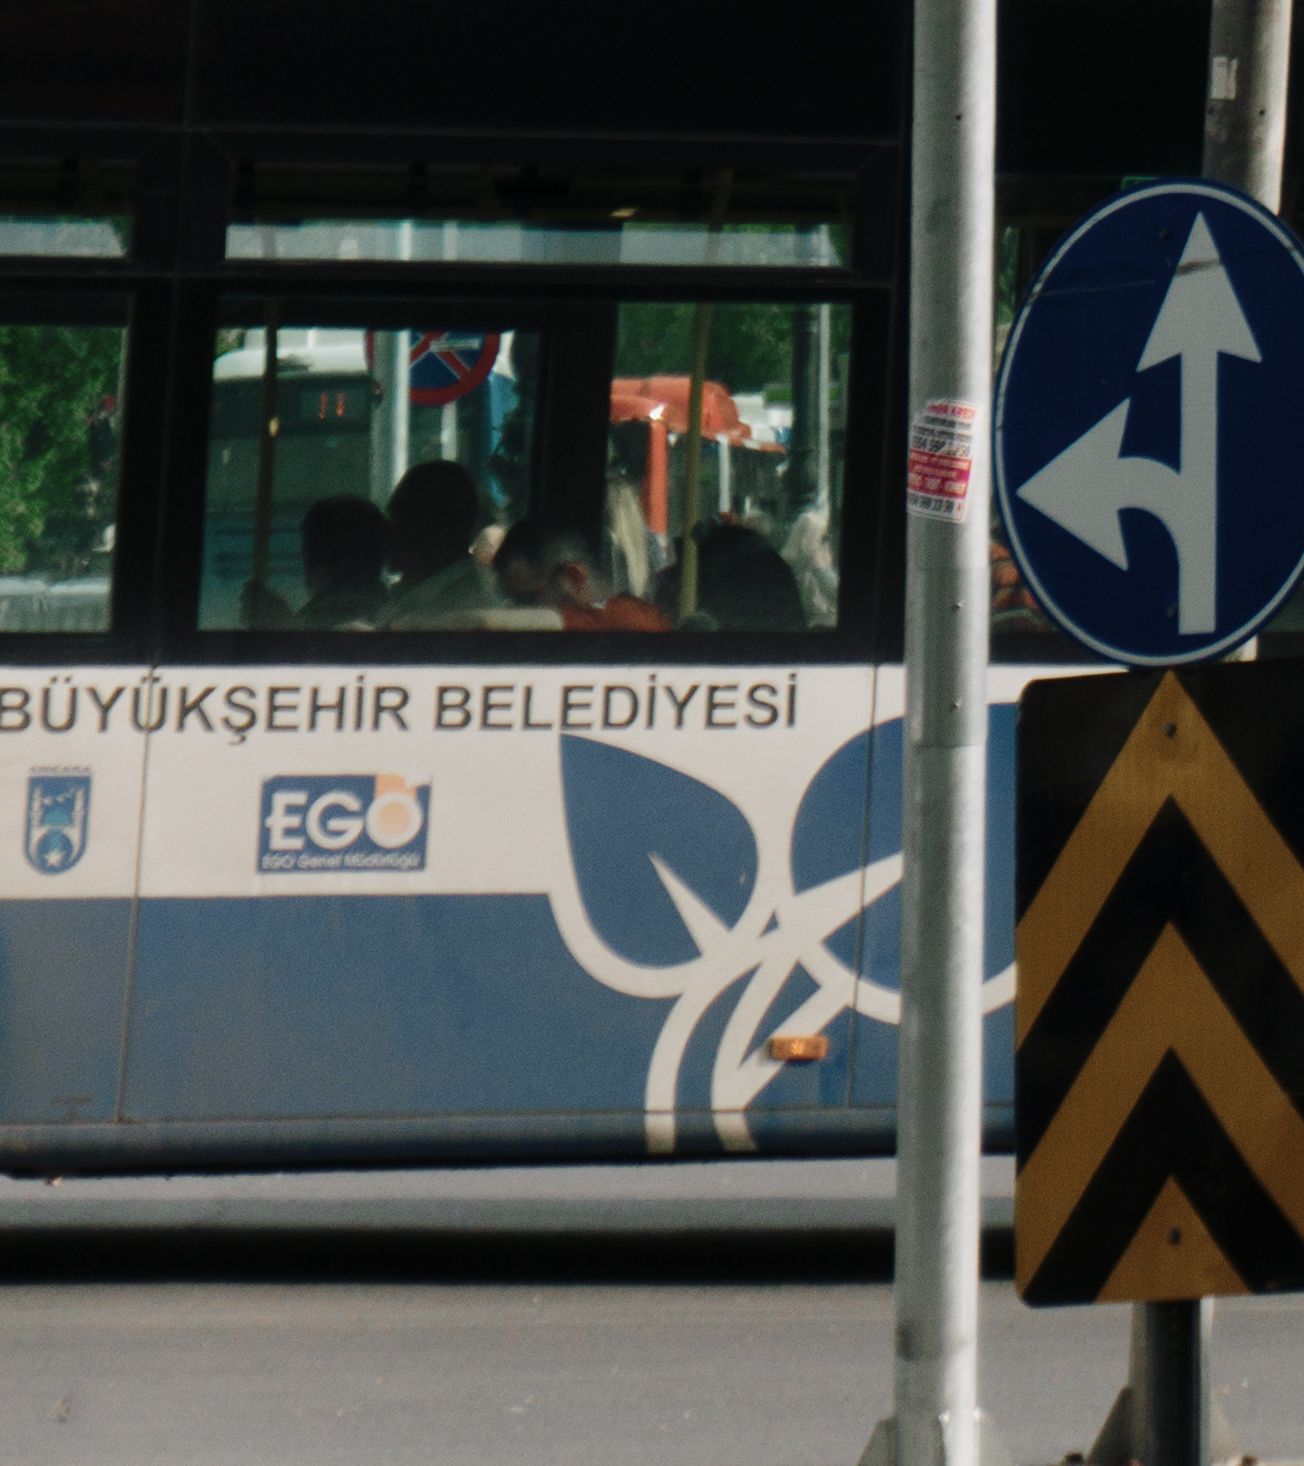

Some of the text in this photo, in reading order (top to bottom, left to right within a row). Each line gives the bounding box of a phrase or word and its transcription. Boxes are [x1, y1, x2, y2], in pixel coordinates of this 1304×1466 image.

[0, 673, 797, 743] BÜYÜKŞEHİR BELEDİYESİ
[265, 790, 424, 851] EGO
